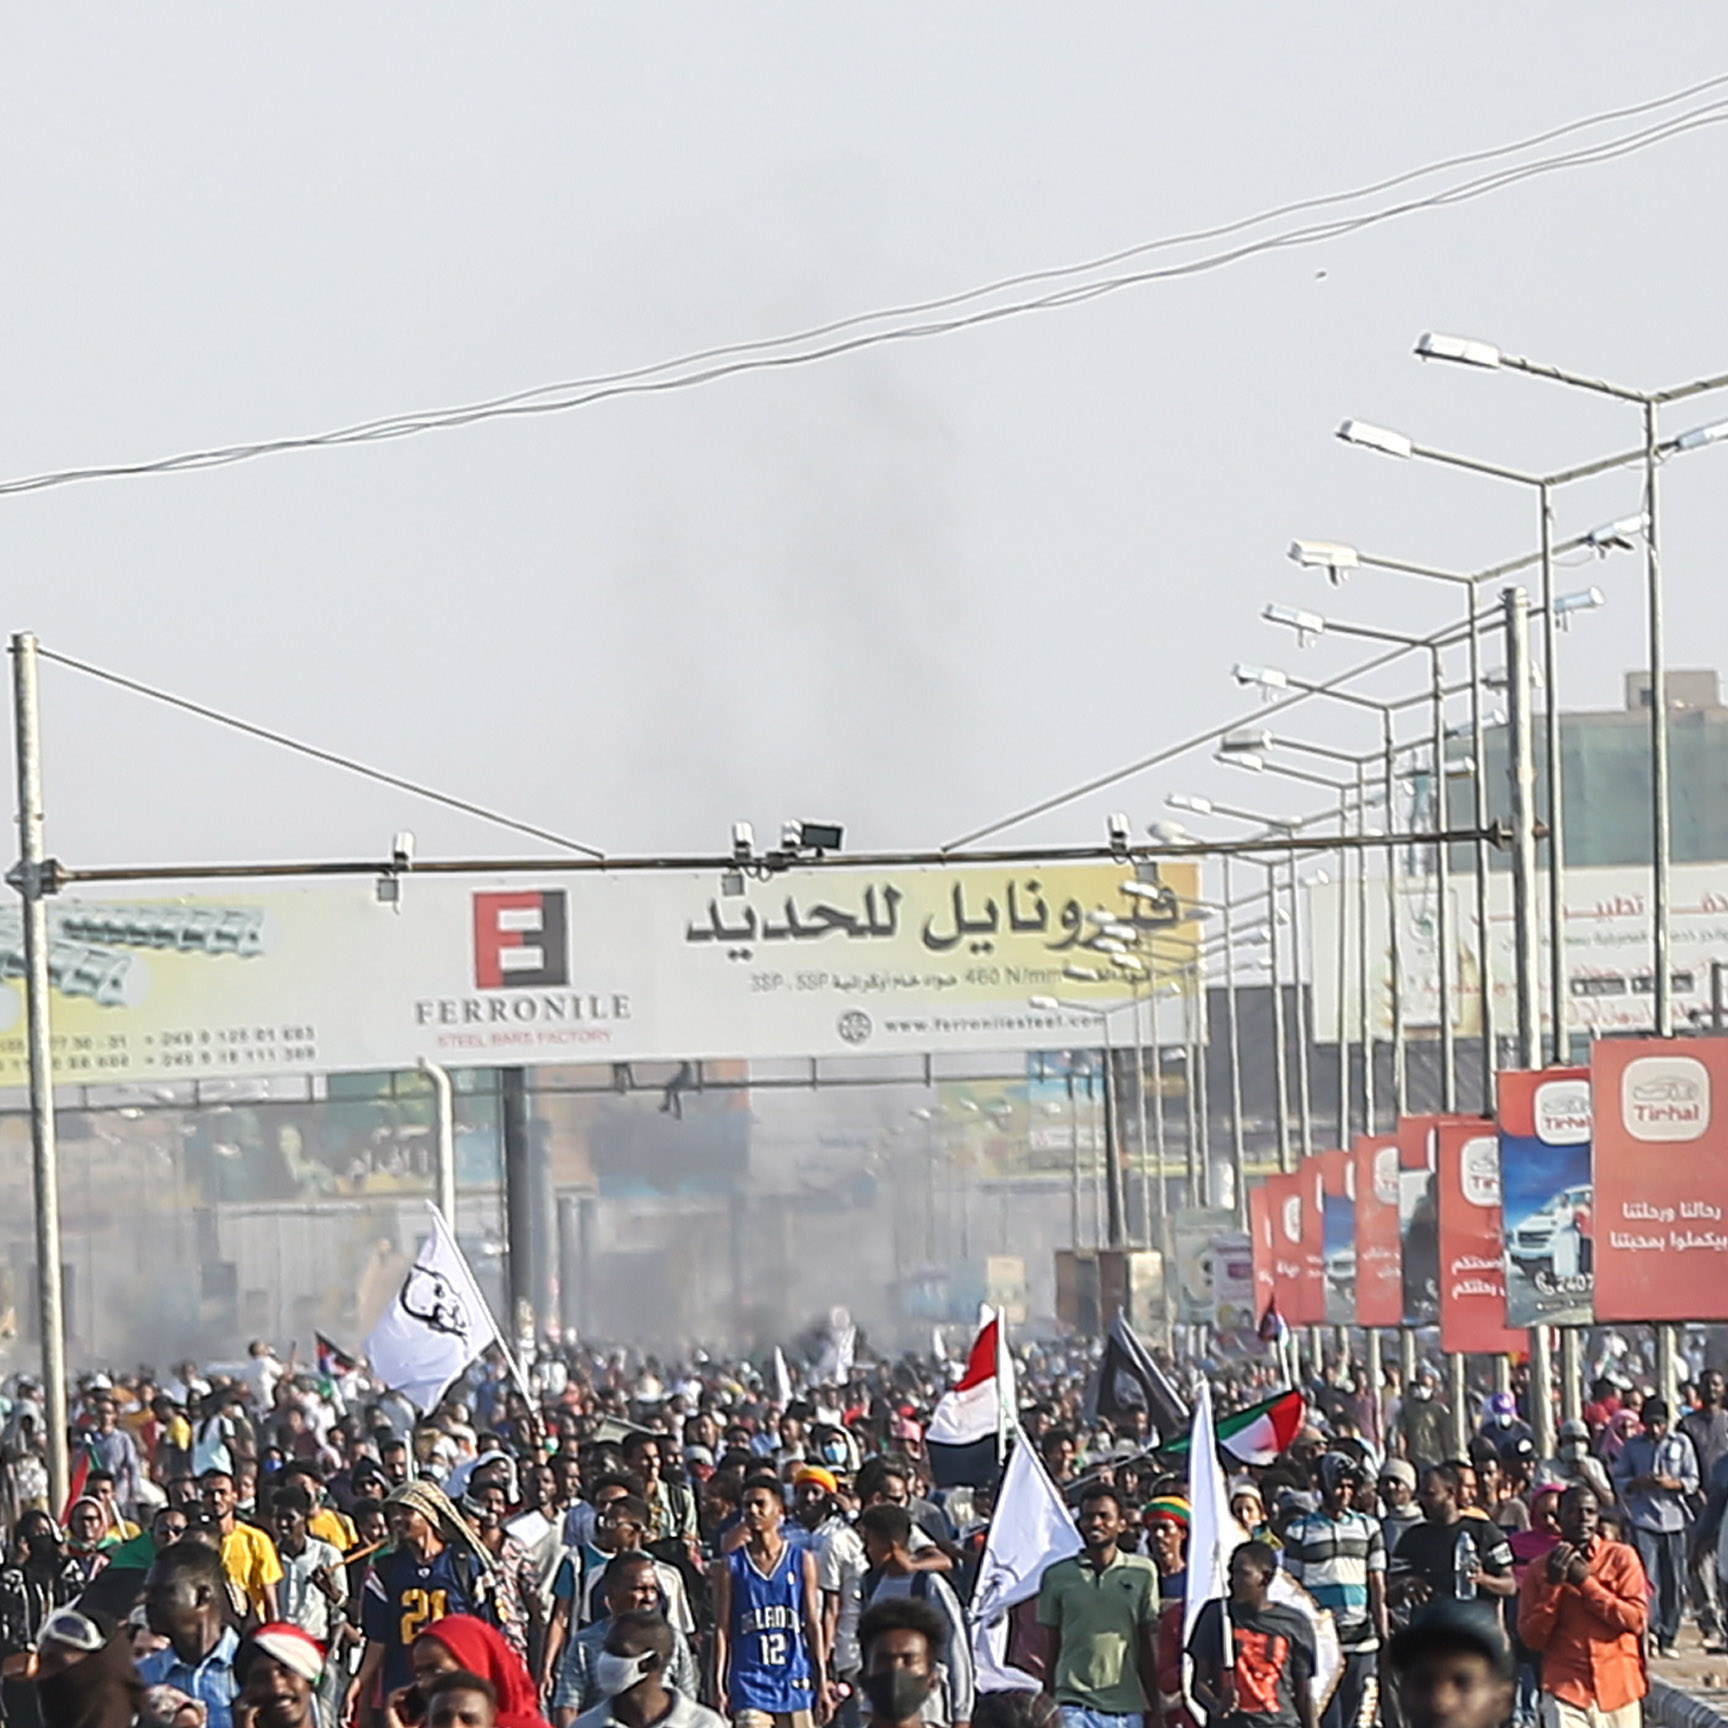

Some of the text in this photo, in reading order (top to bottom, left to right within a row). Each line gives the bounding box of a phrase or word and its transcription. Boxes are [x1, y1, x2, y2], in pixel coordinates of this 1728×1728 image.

[685, 883, 902, 961] للحديد
[415, 993, 632, 1025] FERRONILE
[1633, 1103, 1701, 1122] Tirhal
[401, 1588, 447, 1645] 21
[760, 1633, 786, 1666] 12
